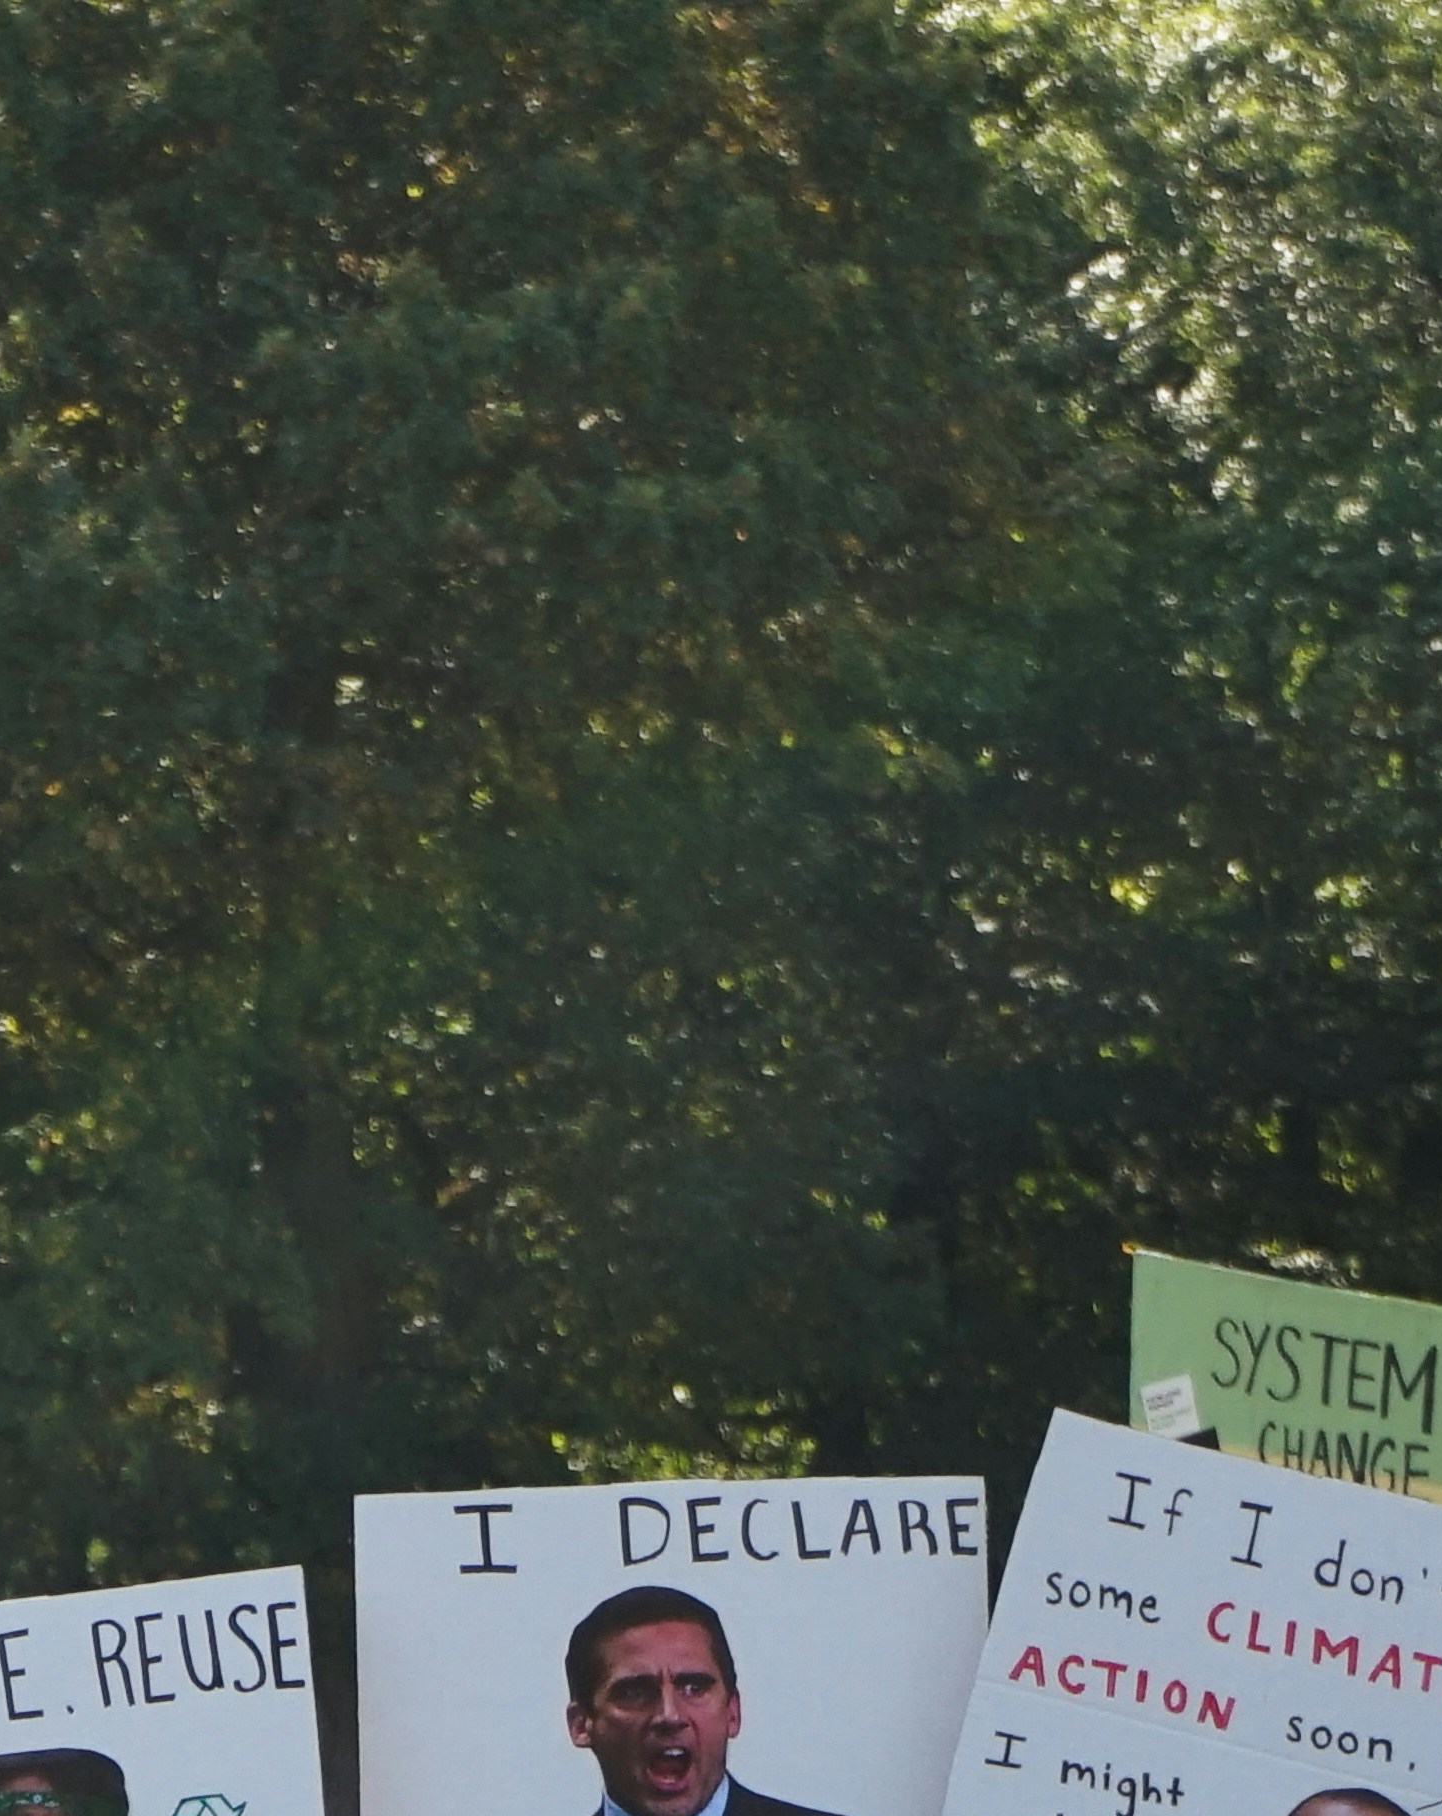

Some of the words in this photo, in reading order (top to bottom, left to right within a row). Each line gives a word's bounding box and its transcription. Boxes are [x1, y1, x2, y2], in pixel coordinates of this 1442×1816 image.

[1210, 1316, 1438, 1436] SYSTEM
[1258, 1420, 1431, 1500] CHANGE
[453, 1503, 518, 1575] I
[618, 1496, 979, 1567] DECLARE
[1107, 1470, 1193, 1538] If
[1230, 1501, 1274, 1570] I
[1044, 1569, 1163, 1625] some
[91, 1601, 307, 1710] REUSE
[1008, 1644, 1237, 1732] ACTION
[984, 1730, 1028, 1771] I
